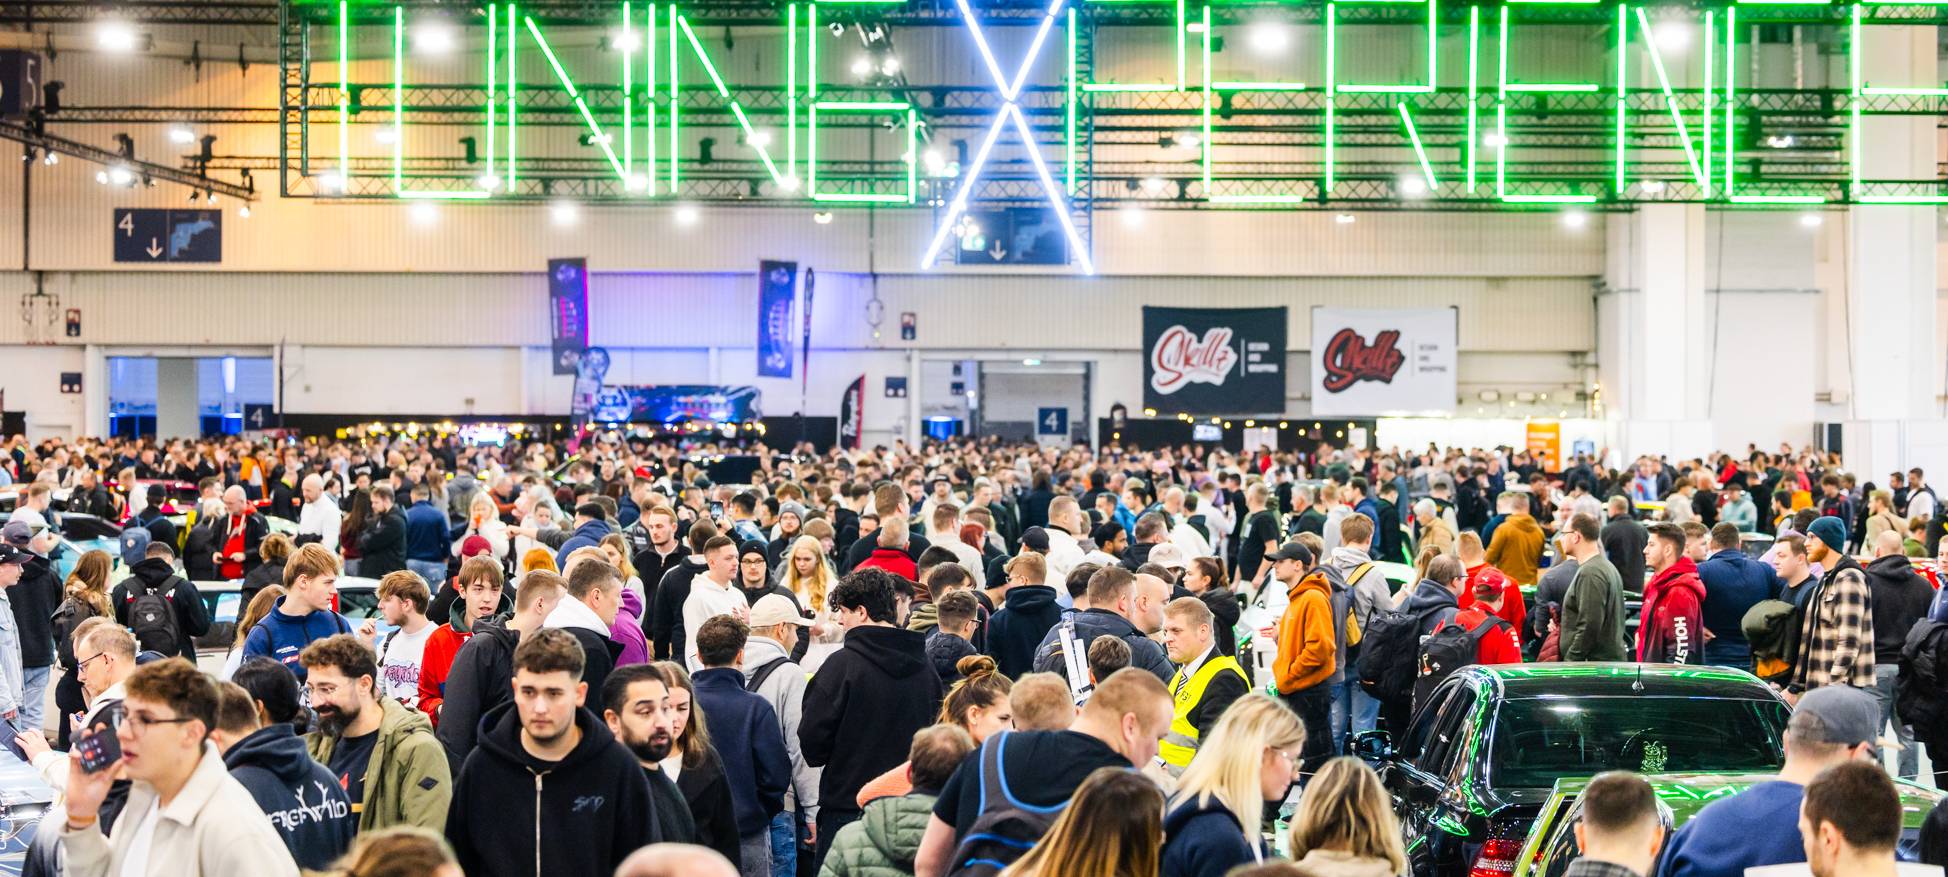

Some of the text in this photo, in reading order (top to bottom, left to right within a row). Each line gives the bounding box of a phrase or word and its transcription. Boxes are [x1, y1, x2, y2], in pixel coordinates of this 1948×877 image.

[117, 212, 135, 238] 4
[1151, 325, 1238, 394] Skillz
[1323, 328, 1404, 393] Skillz
[250, 407, 263, 429] 4
[1044, 410, 1059, 433] 4
